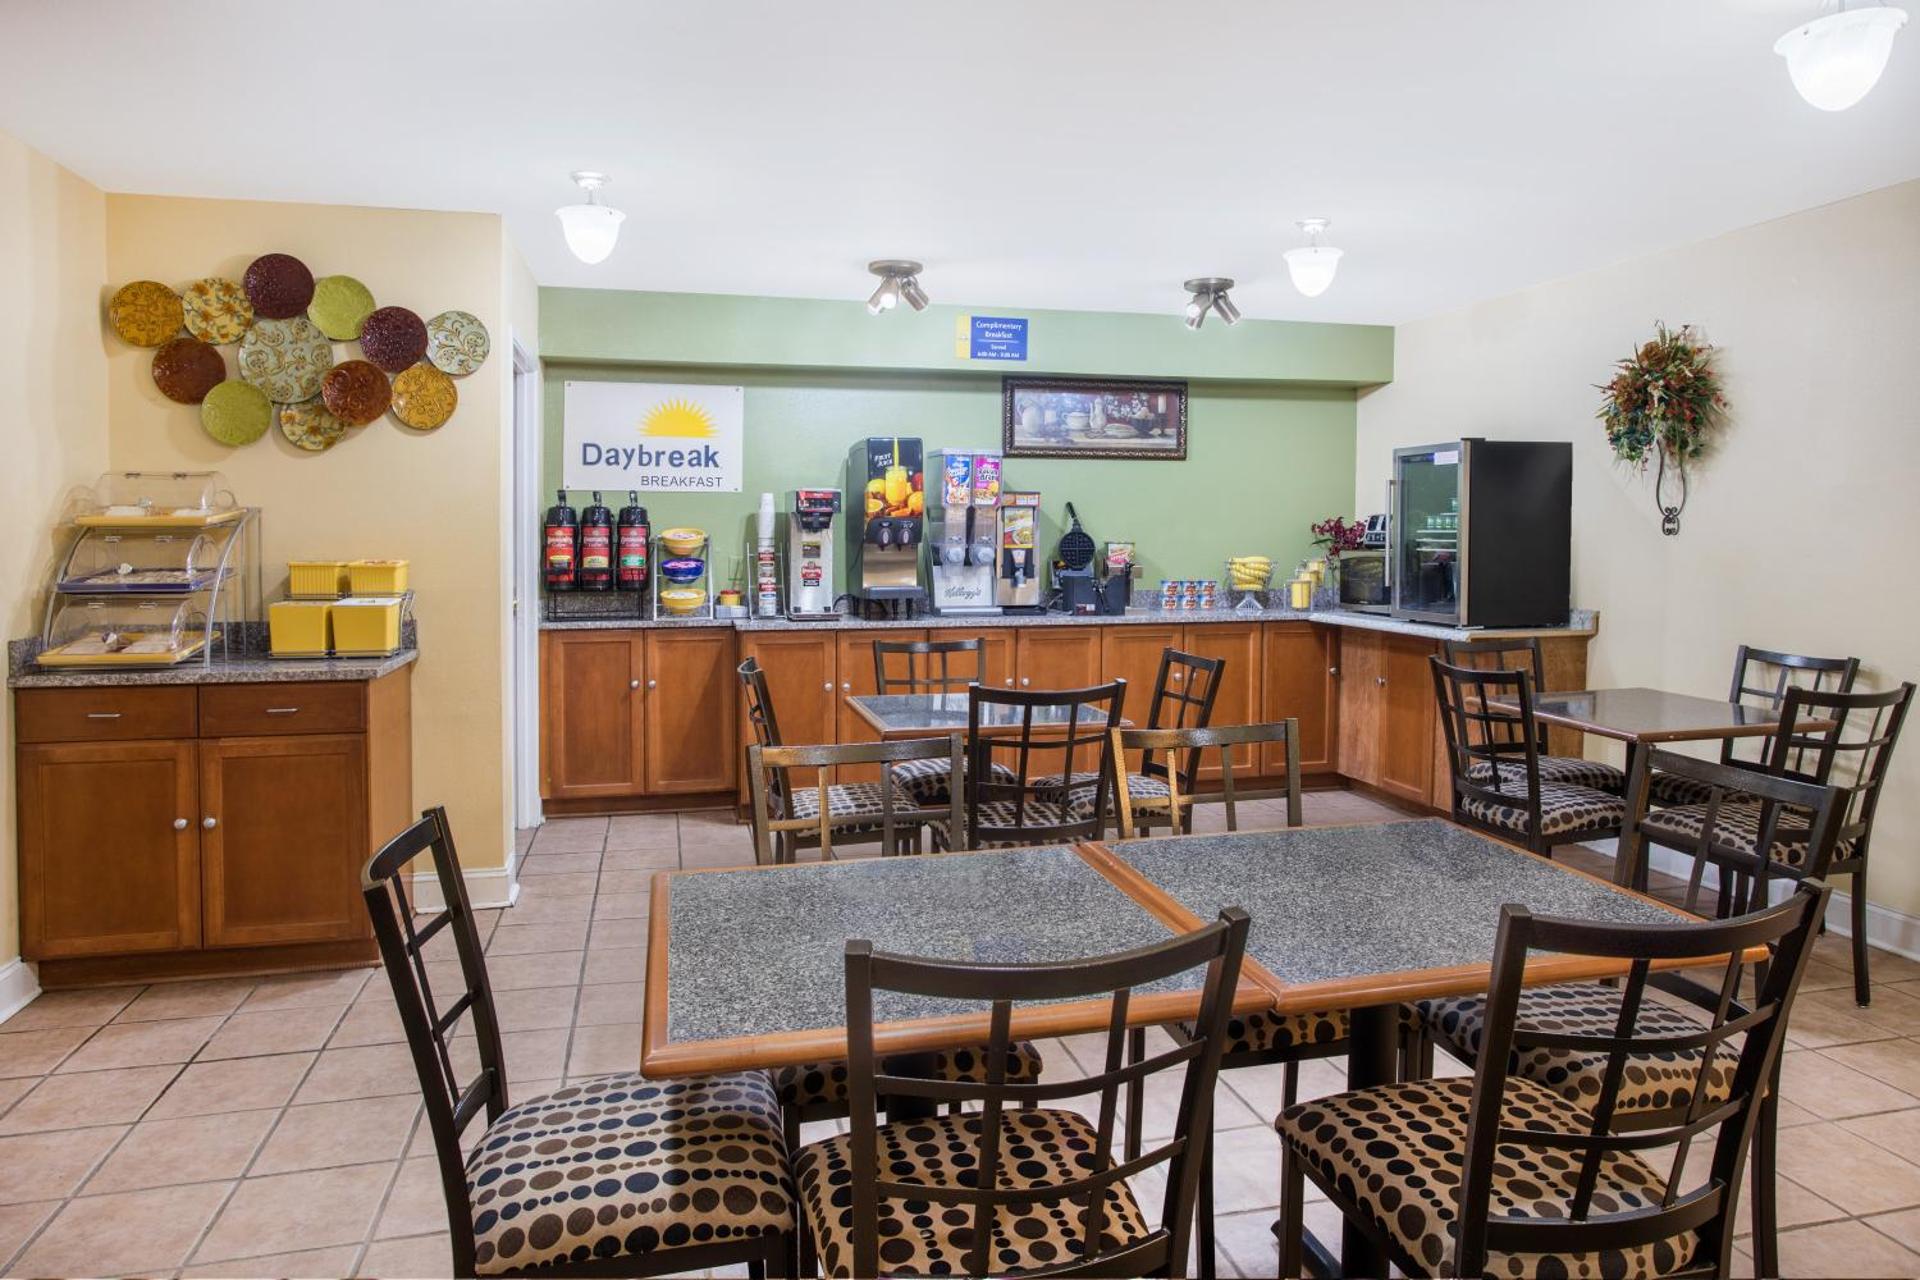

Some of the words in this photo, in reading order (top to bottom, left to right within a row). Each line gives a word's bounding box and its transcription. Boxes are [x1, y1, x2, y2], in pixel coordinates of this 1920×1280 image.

[976, 321, 1022, 331] Complimentary
[582, 442, 720, 470] Daybreak
[640, 475, 723, 488] BREAKFAST
